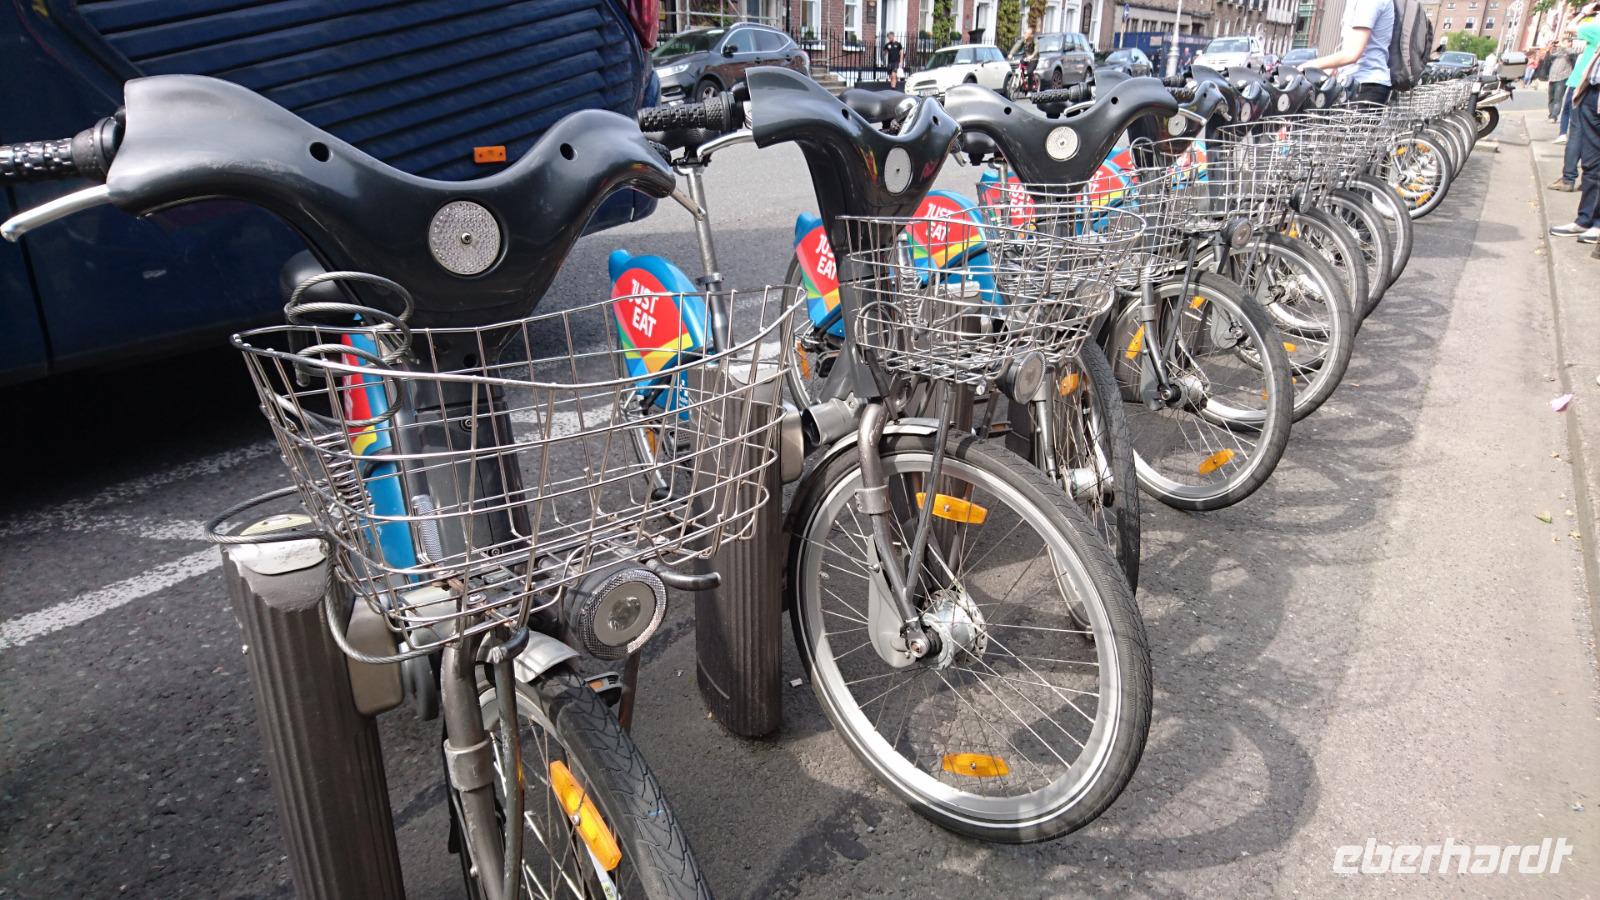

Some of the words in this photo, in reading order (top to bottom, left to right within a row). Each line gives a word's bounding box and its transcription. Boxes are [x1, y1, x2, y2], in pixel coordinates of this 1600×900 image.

[815, 234, 835, 258] JU
[628, 279, 659, 313] JUST
[632, 307, 657, 337] EAT
